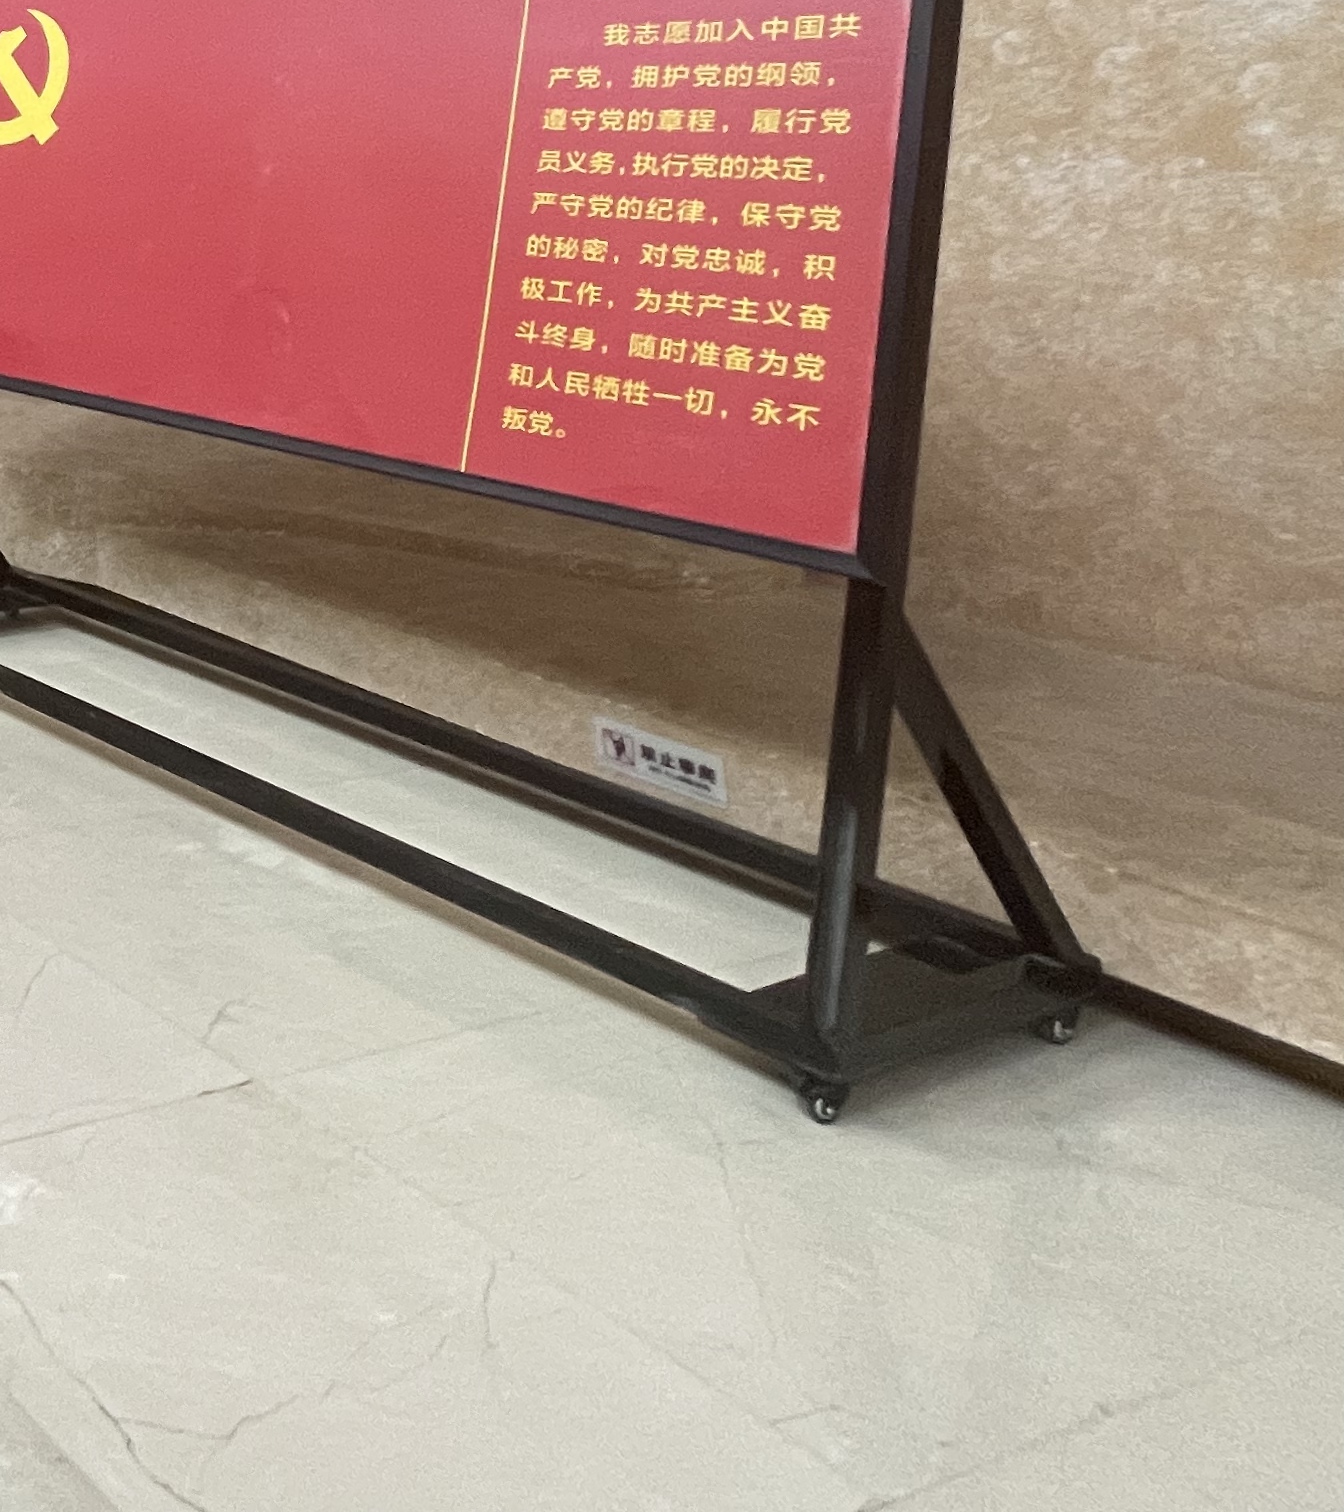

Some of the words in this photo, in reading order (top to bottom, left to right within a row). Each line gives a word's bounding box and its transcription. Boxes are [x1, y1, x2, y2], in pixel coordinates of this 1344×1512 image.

[603, 13, 861, 46] 我志愿加入中国共
[502, 406, 565, 438] 叛党。
